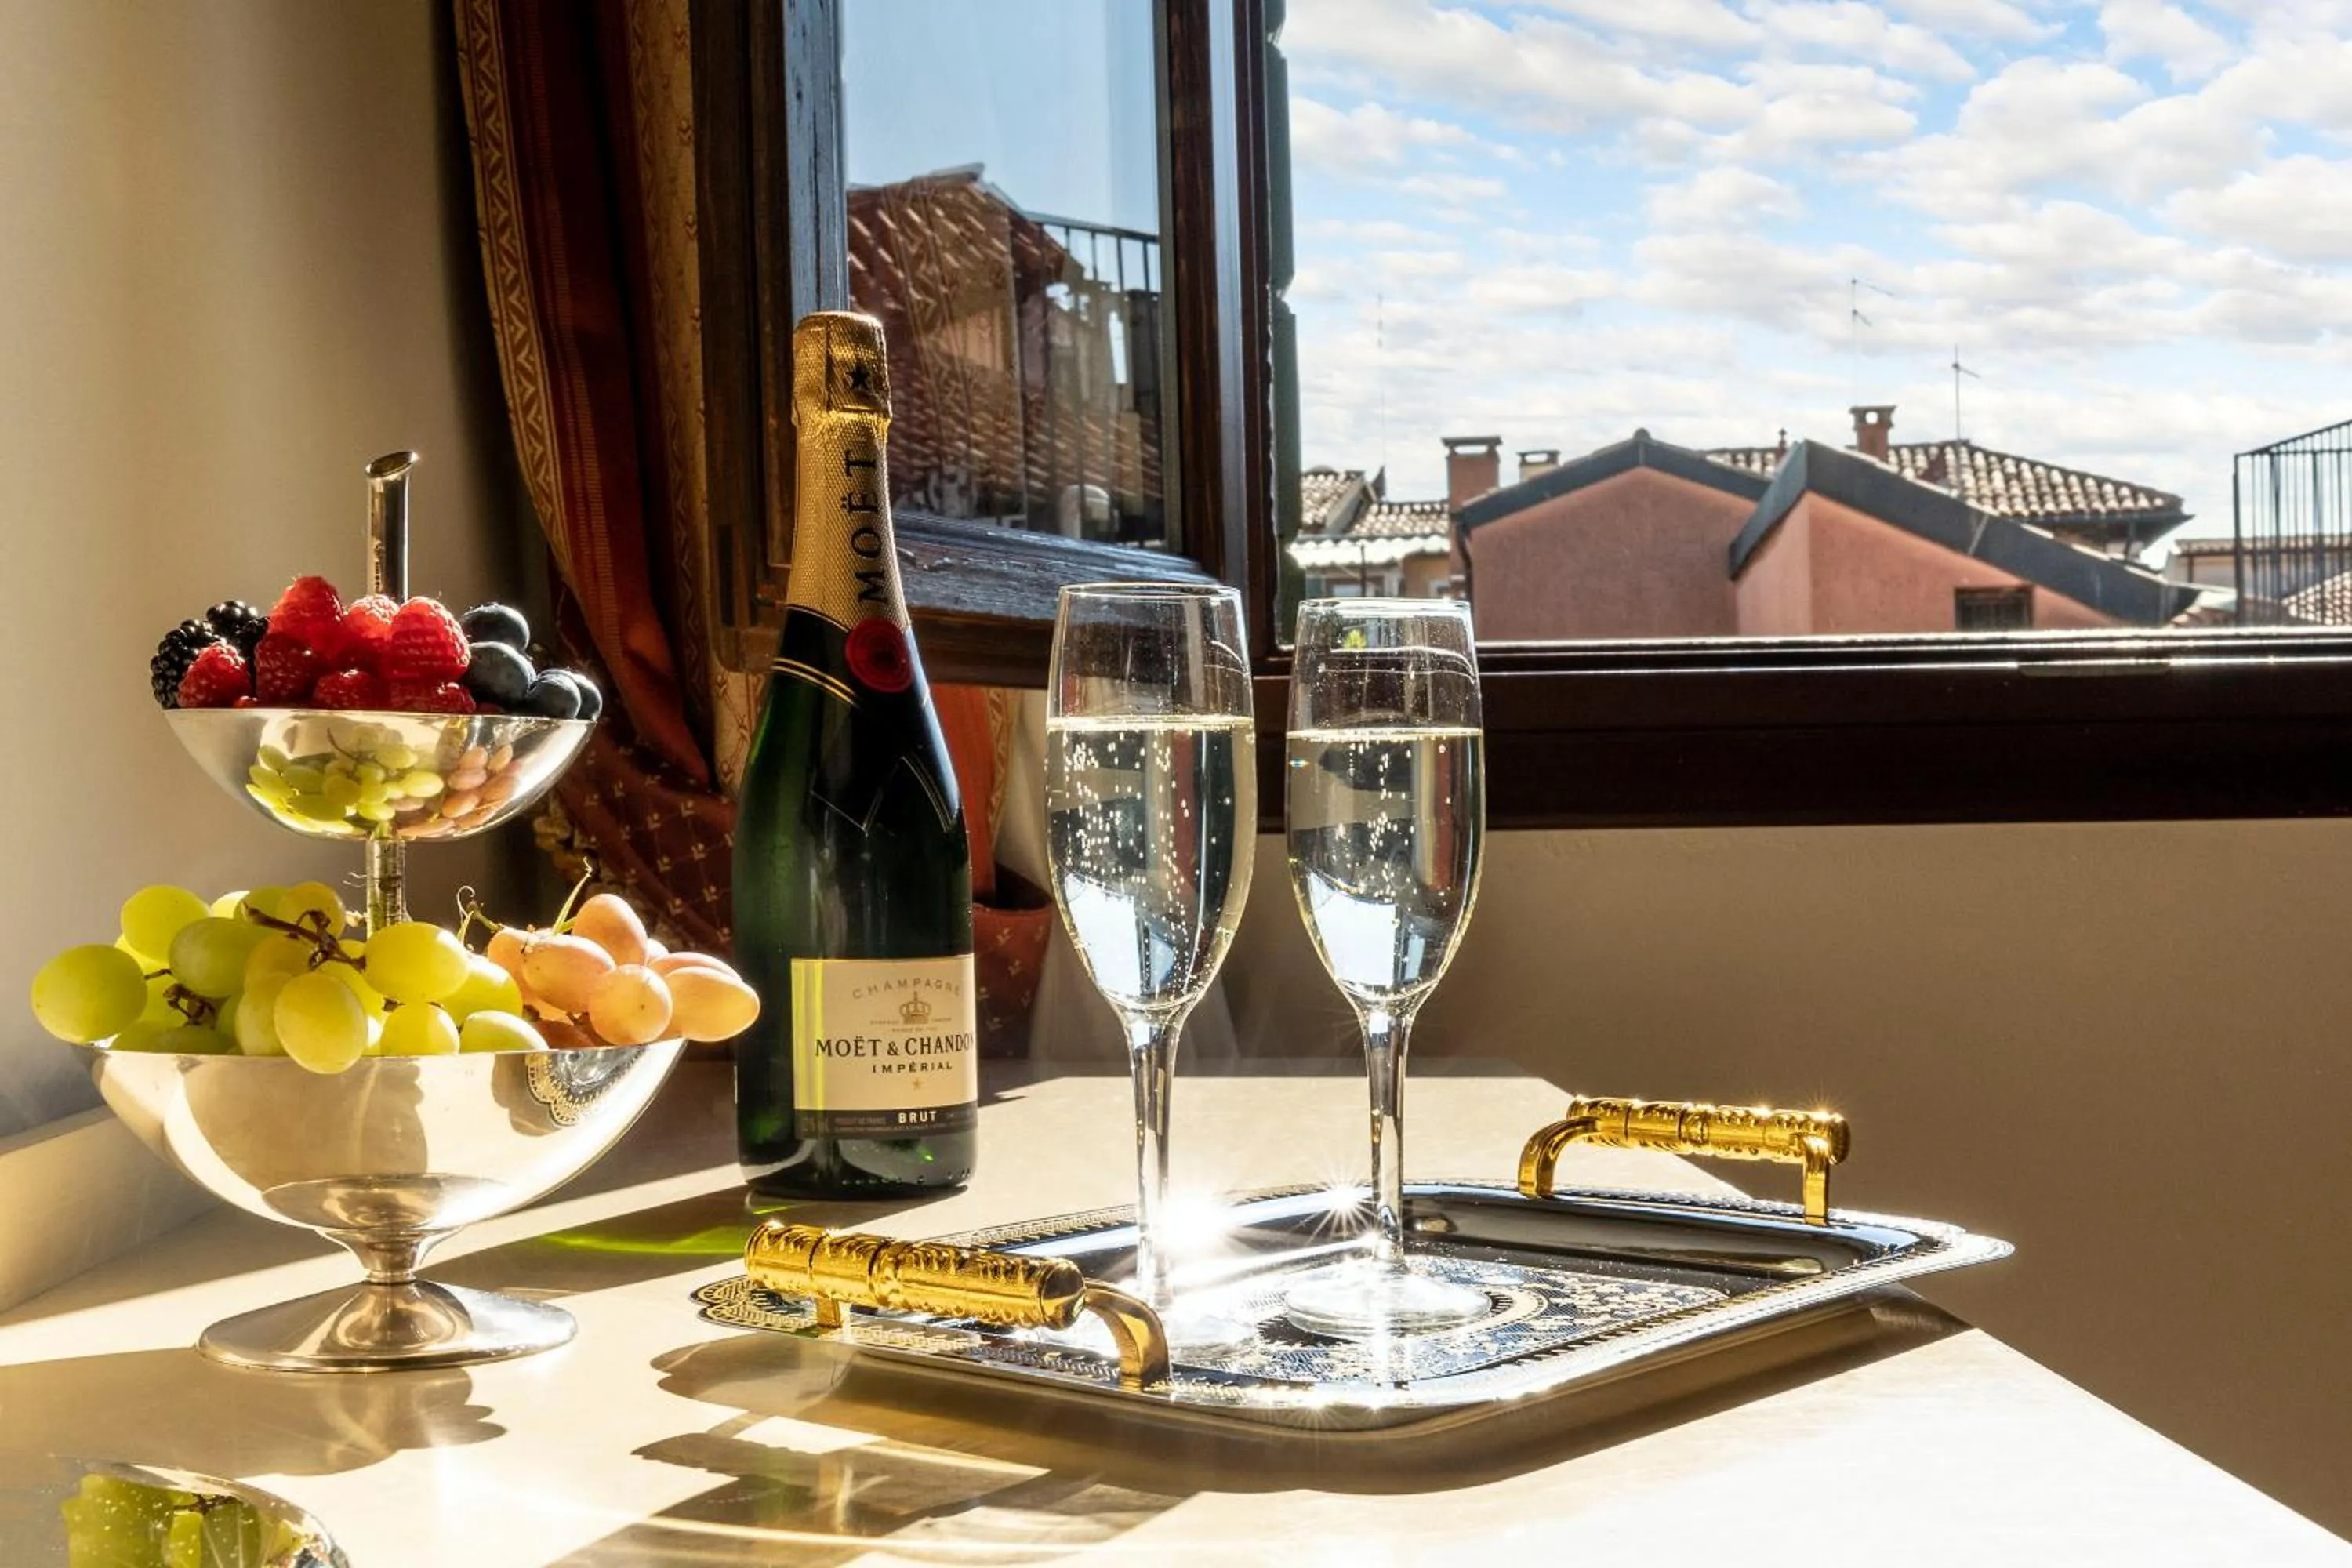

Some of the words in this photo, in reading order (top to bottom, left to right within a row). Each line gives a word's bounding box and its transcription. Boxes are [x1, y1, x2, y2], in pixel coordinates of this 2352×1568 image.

[840, 449, 888, 604] MOËT
[852, 978, 960, 999] CHAMPAGNE
[815, 1036, 882, 1058] MOËT
[887, 1040, 900, 1056] &
[873, 1060, 953, 1073] IMPÉRIAL
[898, 1110, 938, 1123] BRUT
